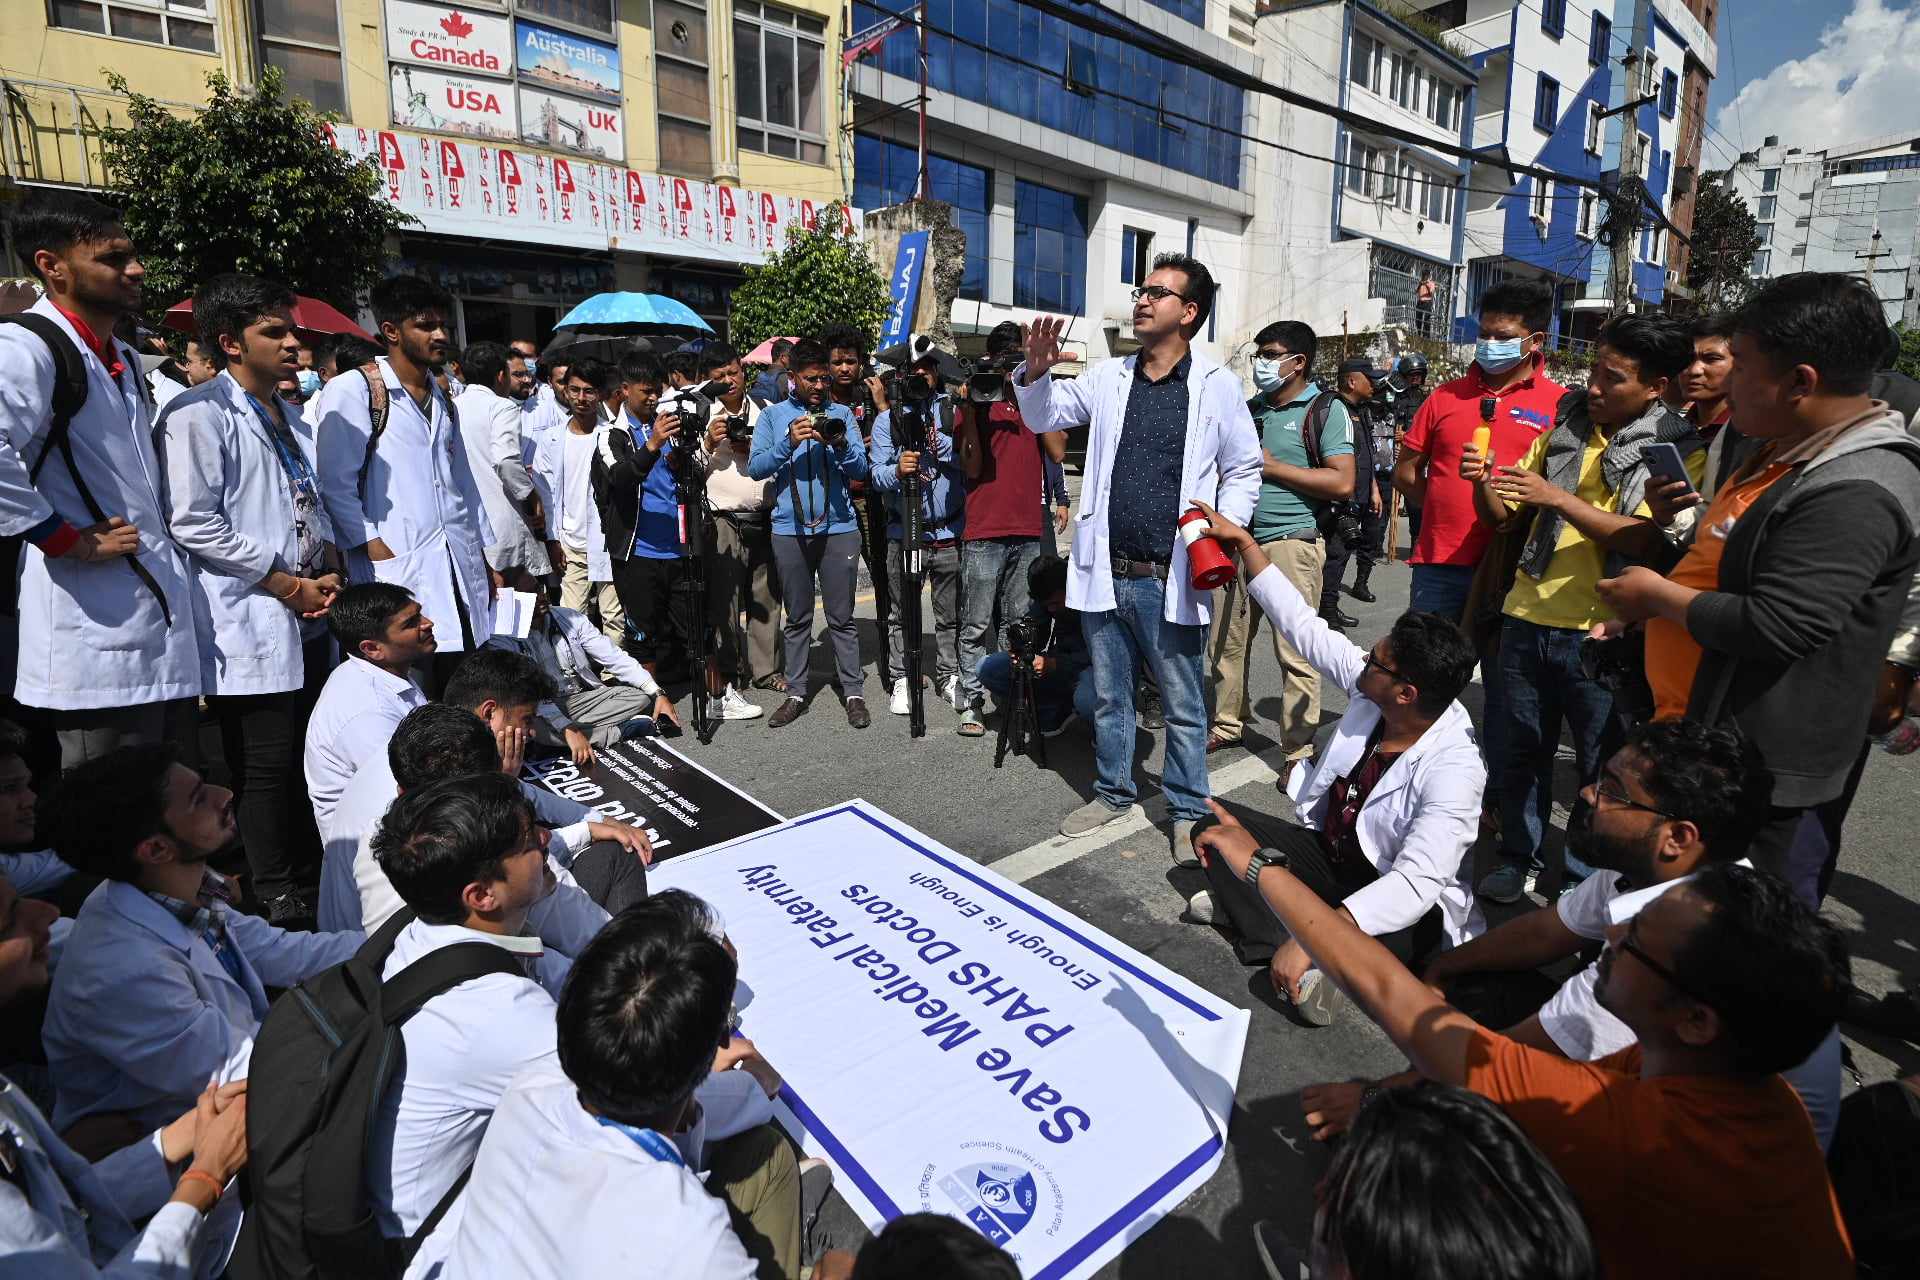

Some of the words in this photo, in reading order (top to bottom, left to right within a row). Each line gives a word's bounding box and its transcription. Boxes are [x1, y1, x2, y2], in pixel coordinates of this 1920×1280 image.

[398, 26, 417, 38] Study
[428, 31, 438, 40] PR
[440, 33, 447, 41] in
[525, 31, 608, 66] Australia
[410, 39, 499, 71] Canada
[446, 79, 463, 88] Study
[447, 87, 501, 114] USA
[587, 109, 617, 132] UK
[890, 247, 915, 335] BAJAJ
[737, 864, 855, 949] Fraternity
[909, 872, 985, 918] Enough
[840, 884, 962, 965] Doctors
[983, 915, 1008, 932] is
[1007, 929, 1102, 991] Enough
[833, 943, 982, 1052] Medical
[947, 962, 1075, 1048] PAHS
[976, 1047, 1091, 1144] Save
[959, 1140, 1002, 1151] Sciences
[1005, 1146, 1037, 1167] Health
[1046, 1170, 1065, 1212] Academy
[1046, 1212, 1063, 1237] Patan
